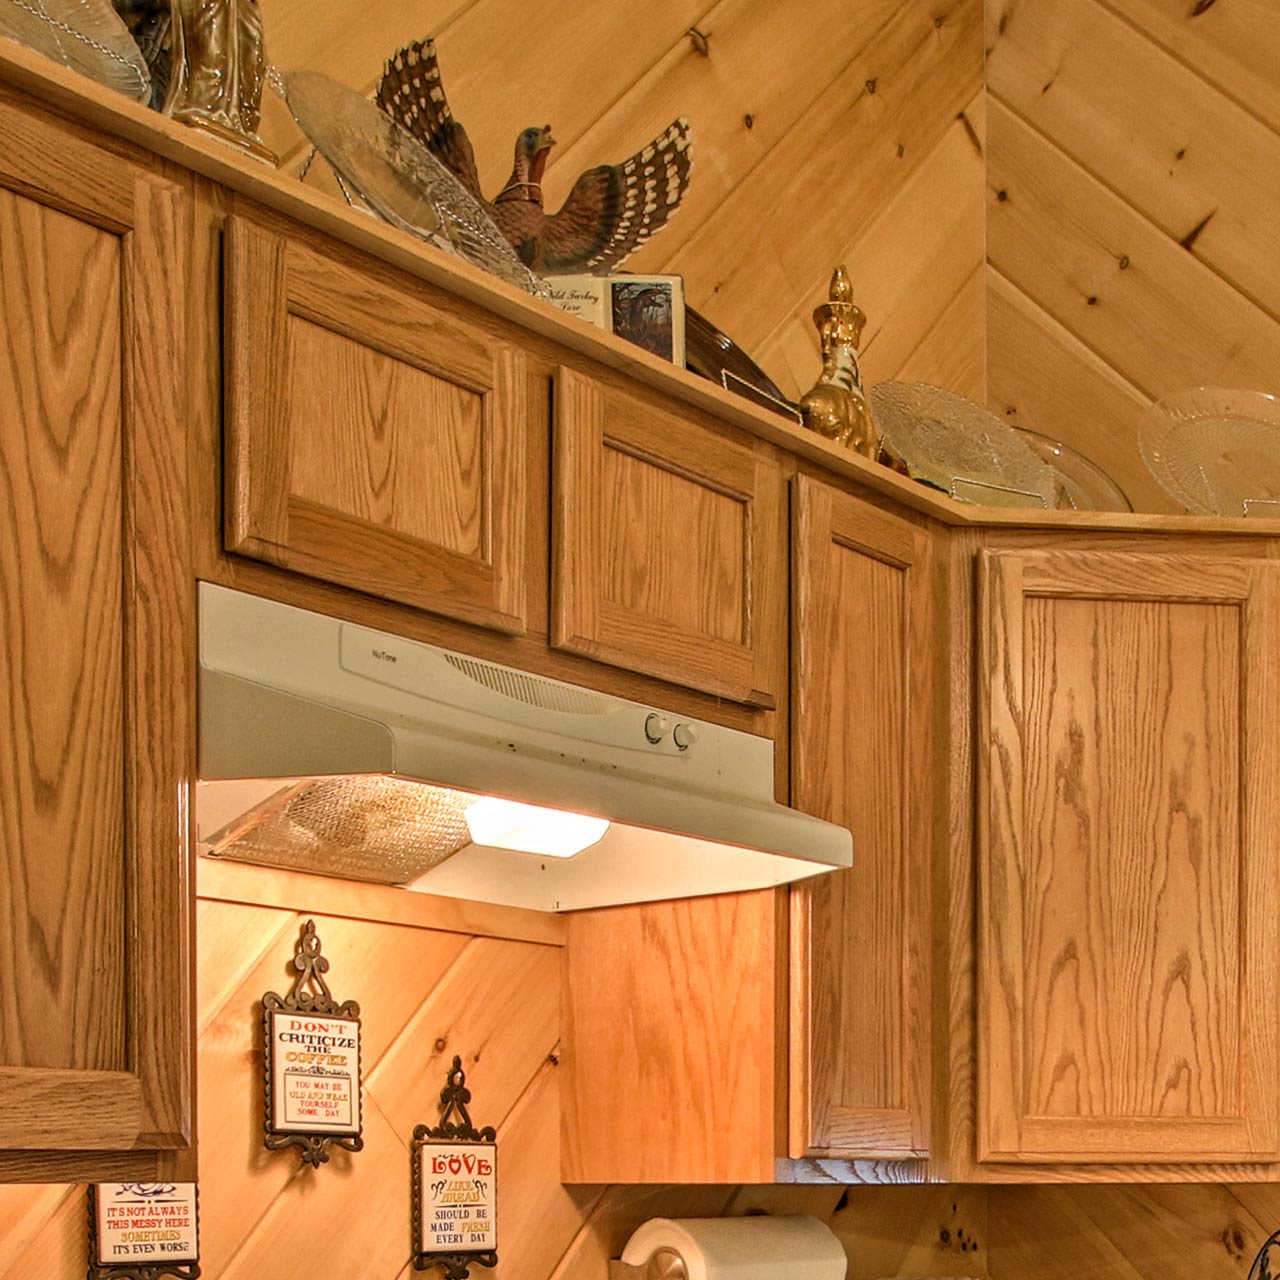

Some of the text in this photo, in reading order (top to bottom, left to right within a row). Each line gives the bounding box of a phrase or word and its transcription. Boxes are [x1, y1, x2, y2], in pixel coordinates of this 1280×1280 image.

[290, 1020, 347, 1035] DON'T
[278, 1032, 356, 1049] CRITICIZE
[304, 1045, 331, 1054] THE
[285, 1052, 347, 1066] COFFEE
[296, 1081, 343, 1091] YOU MAY BE
[289, 1091, 348, 1102] OLD AND WEAK
[300, 1100, 339, 1109] YOURSELF
[297, 1108, 319, 1116] SOME
[431, 1153, 493, 1176] LOVE
[447, 1181, 474, 1192] LIKE
[440, 1191, 481, 1203] BREAD
[126, 1207, 147, 1217] NOT
[147, 1206, 189, 1217] ALWAYS
[435, 1209, 488, 1220] SHOULD BE
[106, 1218, 190, 1230] THIS MESSY HERE
[430, 1221, 491, 1233] MADE FRESH
[121, 1230, 181, 1243] SOMETIMES
[436, 1233, 486, 1244] EVERY DAY
[112, 1242, 190, 1255] IT'S EVEN WORSE
